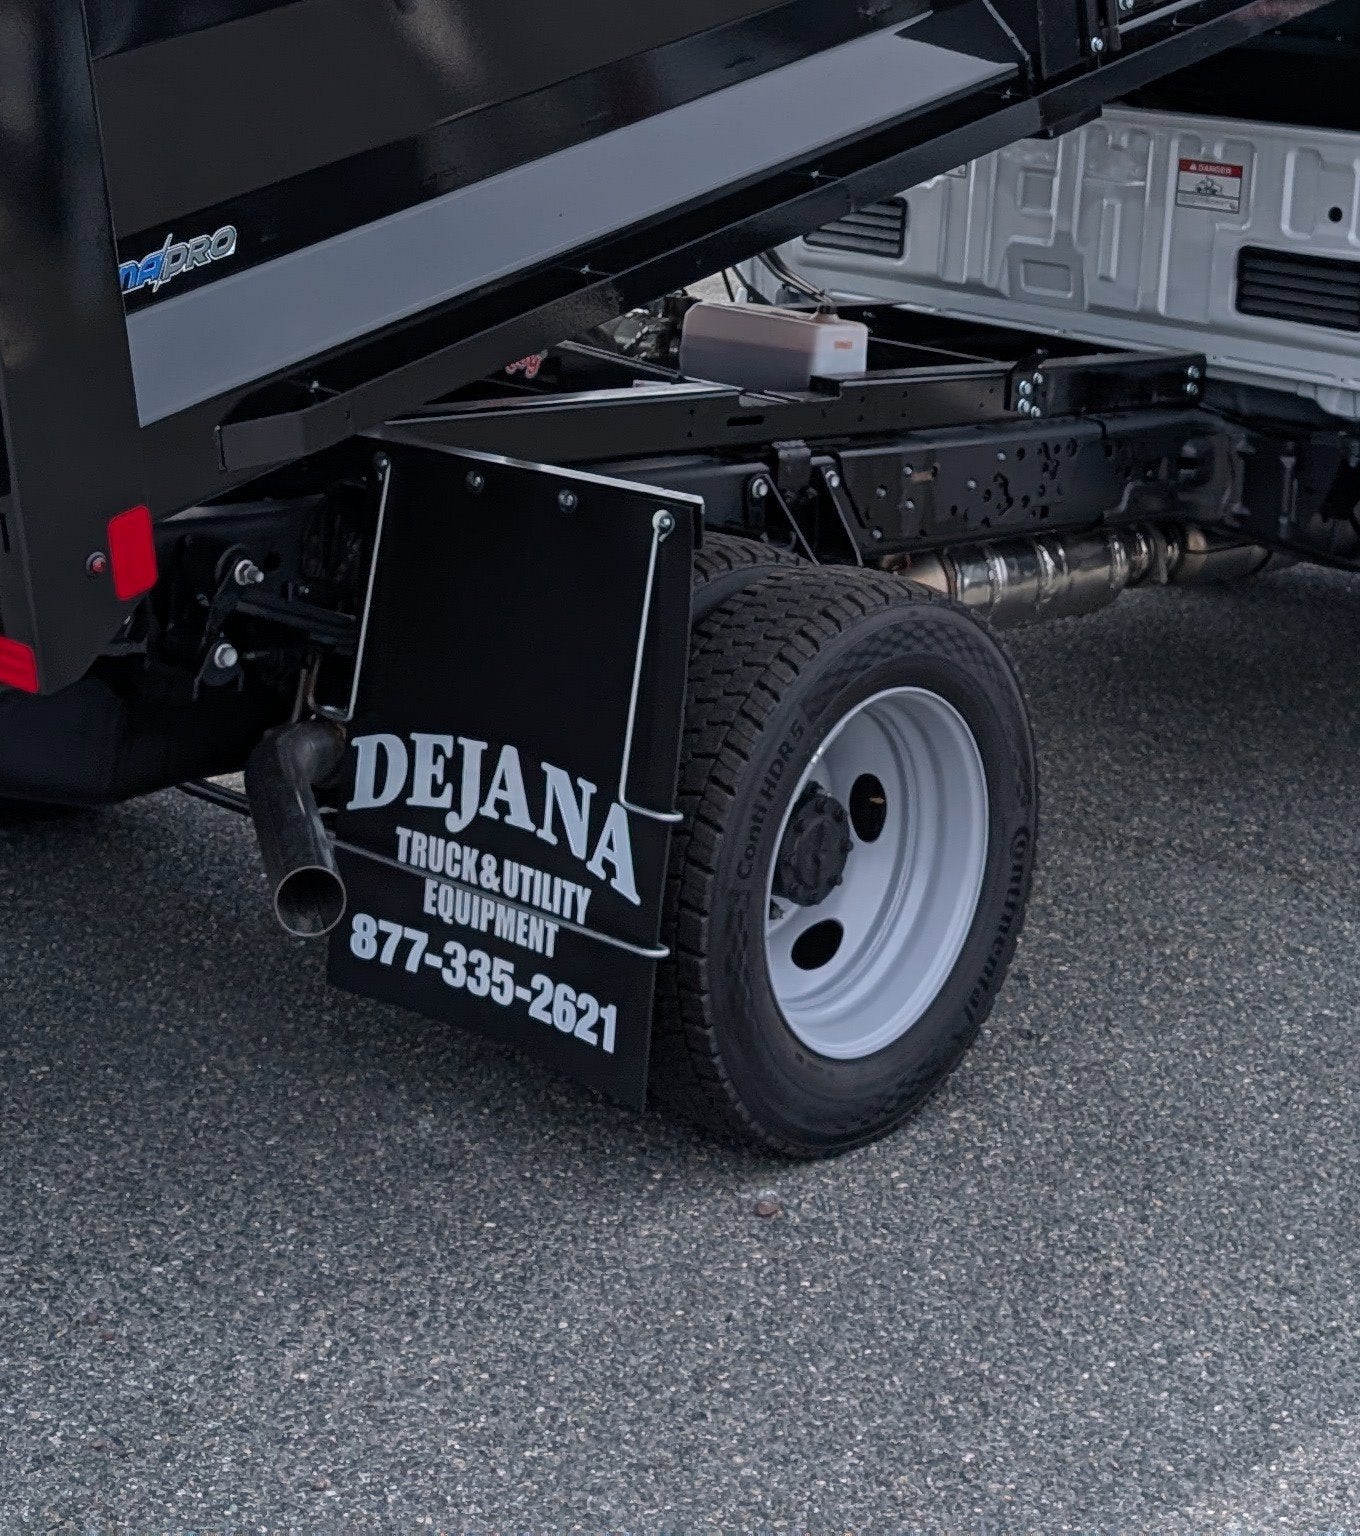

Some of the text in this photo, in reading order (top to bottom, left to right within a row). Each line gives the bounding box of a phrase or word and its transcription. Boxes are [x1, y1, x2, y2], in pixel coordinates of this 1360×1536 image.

[346, 732, 641, 906] DEJANA
[760, 740, 793, 801] HDR
[423, 877, 560, 959] EQUIPMENT
[350, 913, 617, 1054] 877-335-2621
